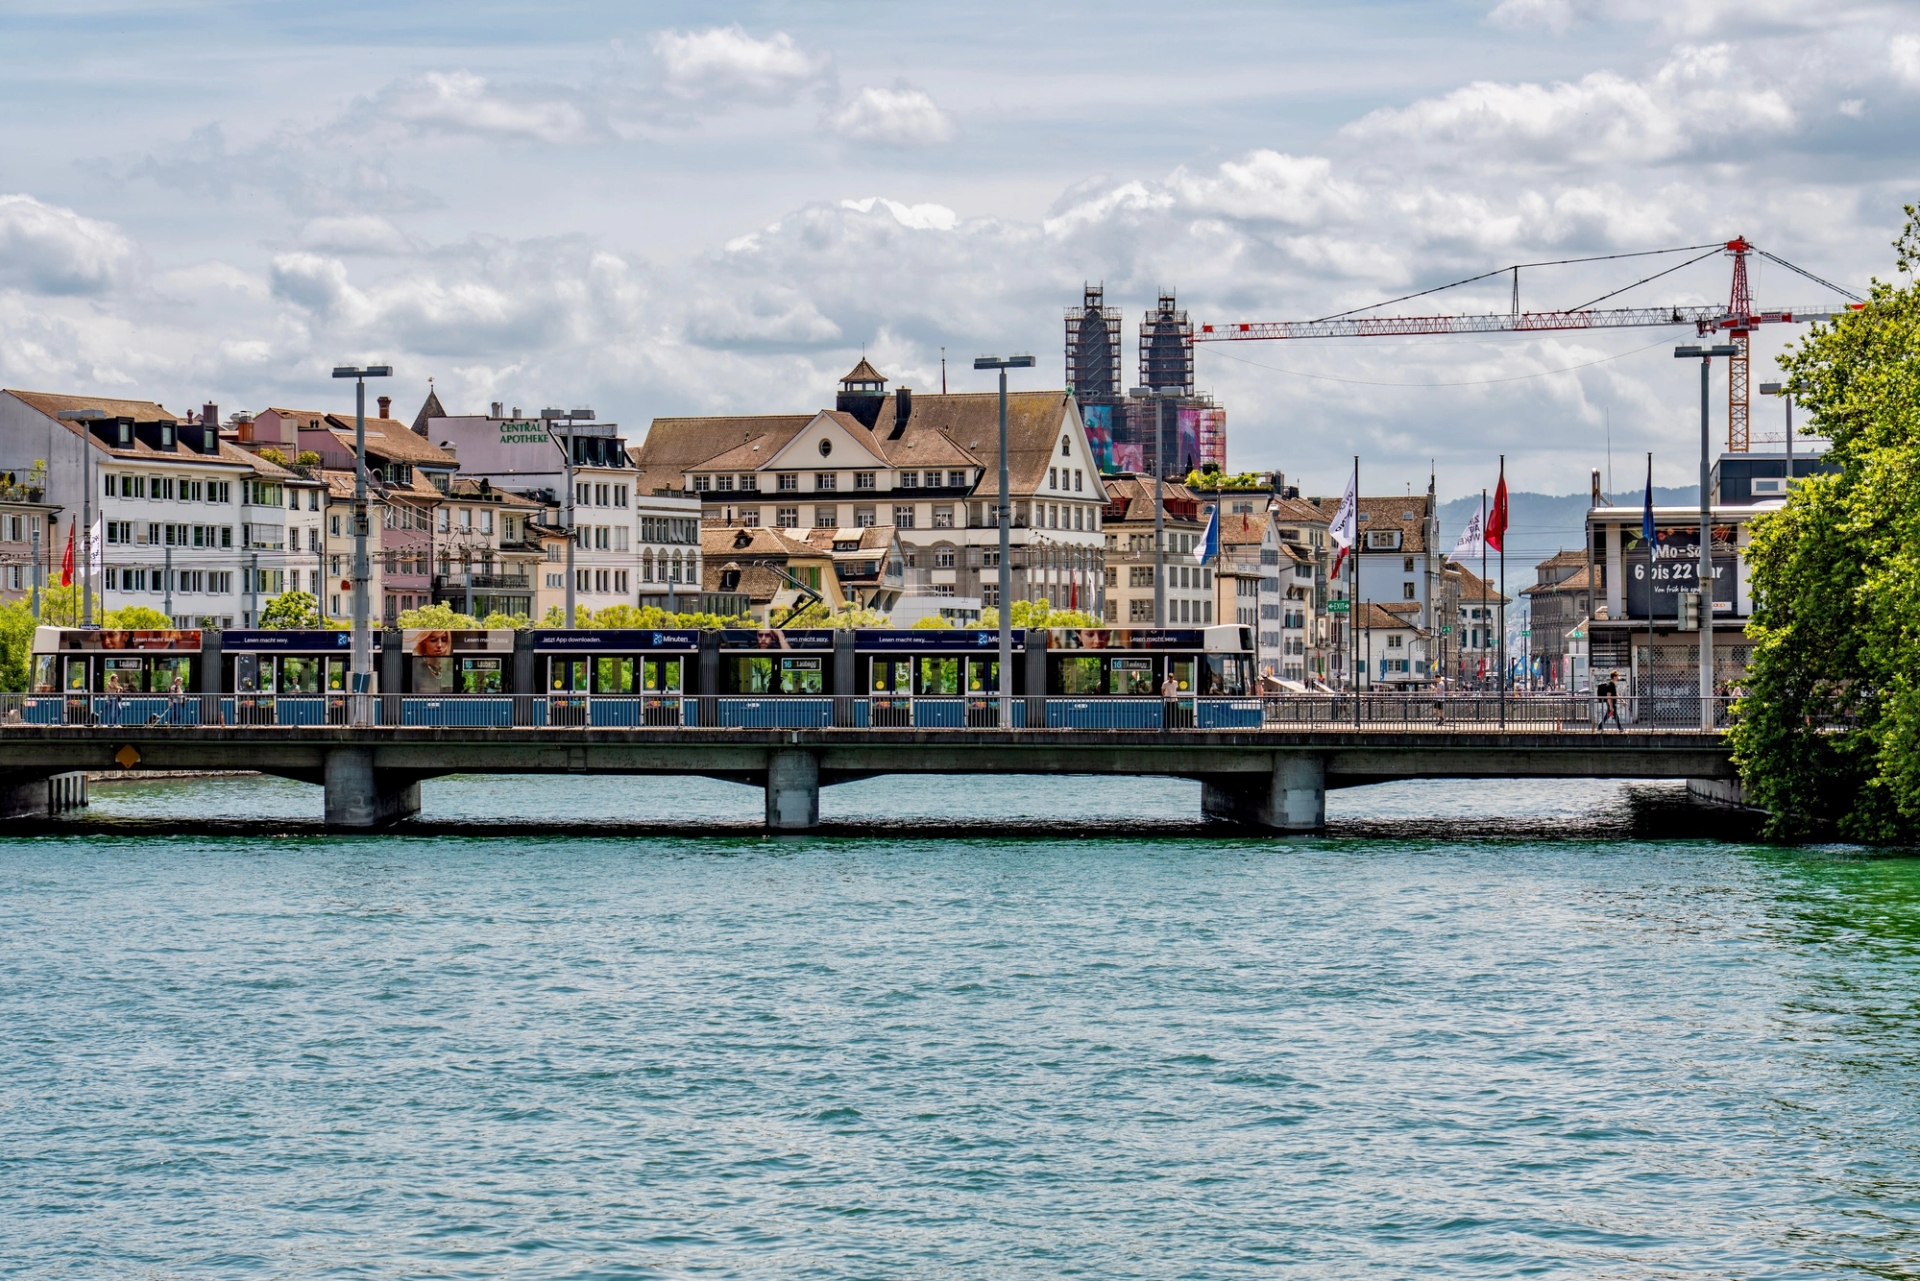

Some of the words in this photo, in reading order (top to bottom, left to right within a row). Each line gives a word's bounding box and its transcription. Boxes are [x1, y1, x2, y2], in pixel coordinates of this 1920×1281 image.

[500, 423, 542, 432] CENTRAL
[500, 434, 548, 444] APOTHEKE
[1656, 544, 1702, 558] Mo-Sa
[1634, 564, 1644, 580] 6
[1672, 563, 1692, 579] 22
[338, 634, 347, 645] 20
[653, 634, 662, 644] 20
[978, 634, 988, 644] 20
